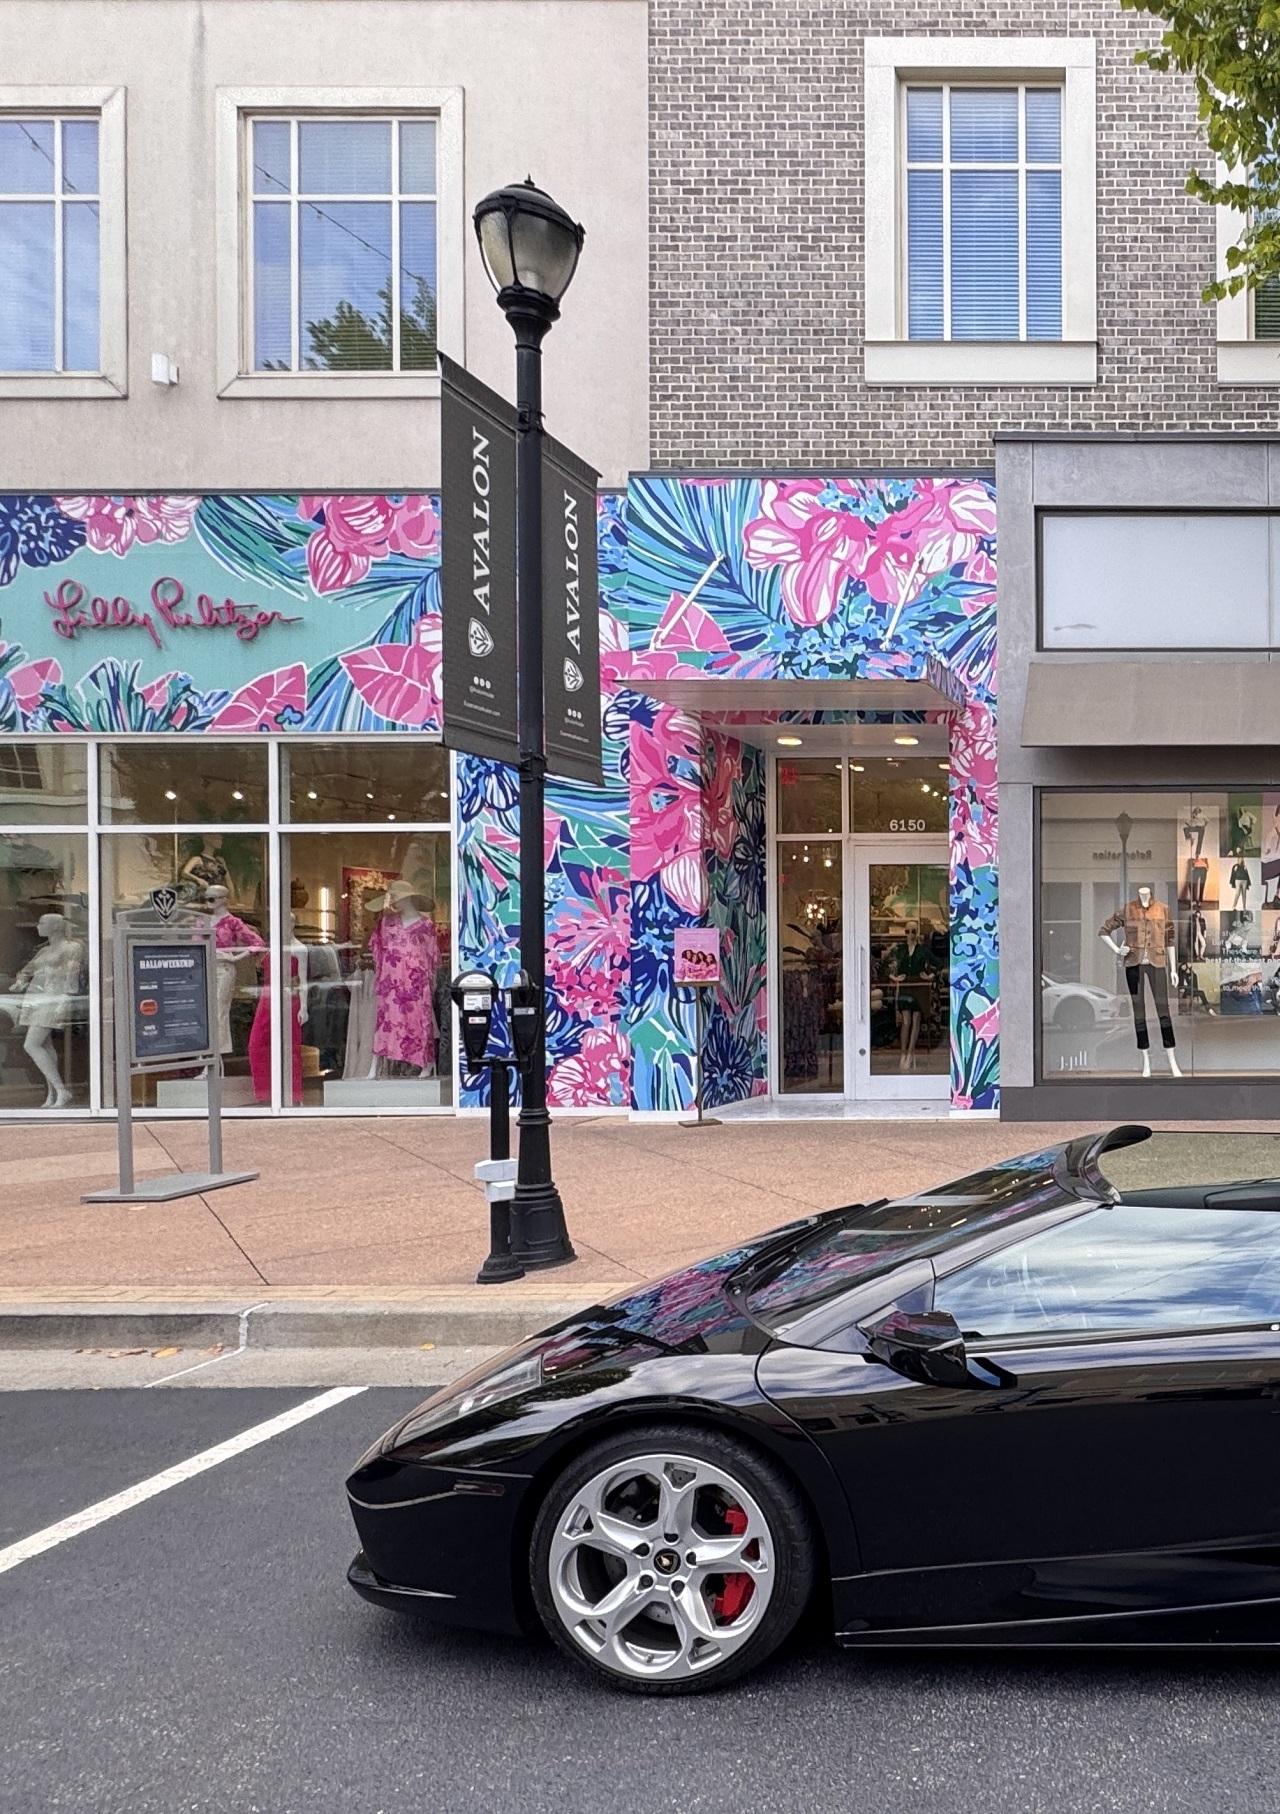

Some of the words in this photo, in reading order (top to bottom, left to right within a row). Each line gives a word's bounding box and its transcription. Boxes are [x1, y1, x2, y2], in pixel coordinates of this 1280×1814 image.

[472, 426, 491, 617] AVALON
[563, 490, 582, 656] AVALON
[43, 578, 162, 649] Lilly
[151, 576, 304, 640] Pulitzer
[889, 819, 926, 832] 6150
